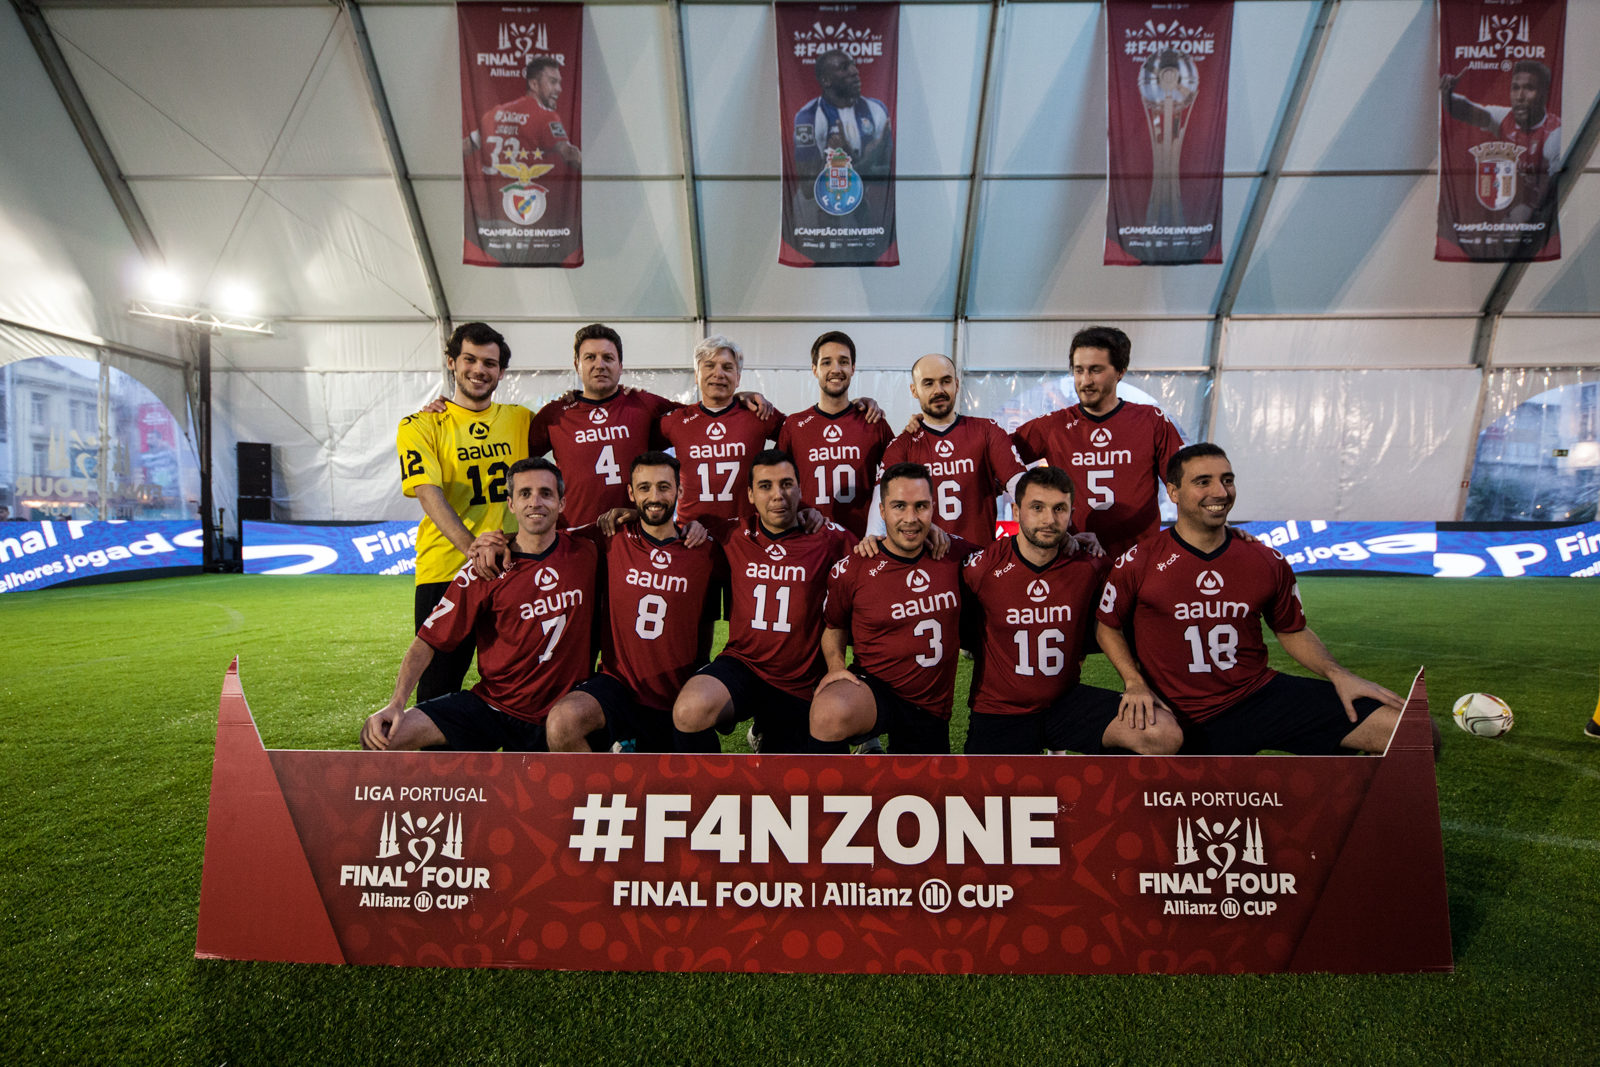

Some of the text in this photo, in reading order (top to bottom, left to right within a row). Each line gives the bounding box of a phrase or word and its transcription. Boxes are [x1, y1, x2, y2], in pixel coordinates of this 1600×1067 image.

[477, 53, 565, 66] FINAL FR
[1455, 46, 1546, 59] FINAL FOUR
[490, 68, 520, 77] Allianz
[1468, 61, 1499, 70] Allianz
[575, 425, 630, 444] aaum
[457, 442, 512, 462] aaum
[689, 442, 746, 459] aaum
[808, 445, 861, 462] aaum
[1071, 449, 1132, 466] aaum
[400, 449, 425, 481] 12
[595, 445, 622, 485] 4
[466, 461, 509, 506] 12
[697, 461, 741, 502] 17
[813, 464, 856, 505] 10
[1086, 469, 1115, 511] 5
[937, 480, 963, 521] 6
[625, 568, 688, 593] aaum
[745, 562, 806, 582] aaum
[422, 596, 455, 629] 7
[519, 588, 583, 620] aaum
[635, 593, 668, 640] 8
[751, 583, 792, 633] 11
[890, 590, 958, 620] aaum
[1006, 605, 1072, 625] aaum
[1174, 600, 1250, 620] aaum
[538, 613, 567, 665] 7
[913, 618, 943, 668] 3
[1183, 623, 1239, 674] 18
[1013, 628, 1065, 677] 16
[355, 786, 487, 802] LIGA PORTUGAL
[1143, 791, 1283, 807] LIGA PORTUGAL
[340, 864, 490, 889] FINAL FOUR
[1139, 872, 1297, 894] FINAL FOUR
[359, 892, 469, 910] Allianz CUP
[613, 880, 1014, 908] FINAL FOUR Allianz CUP
[1163, 900, 1277, 916] Allianz CUP
